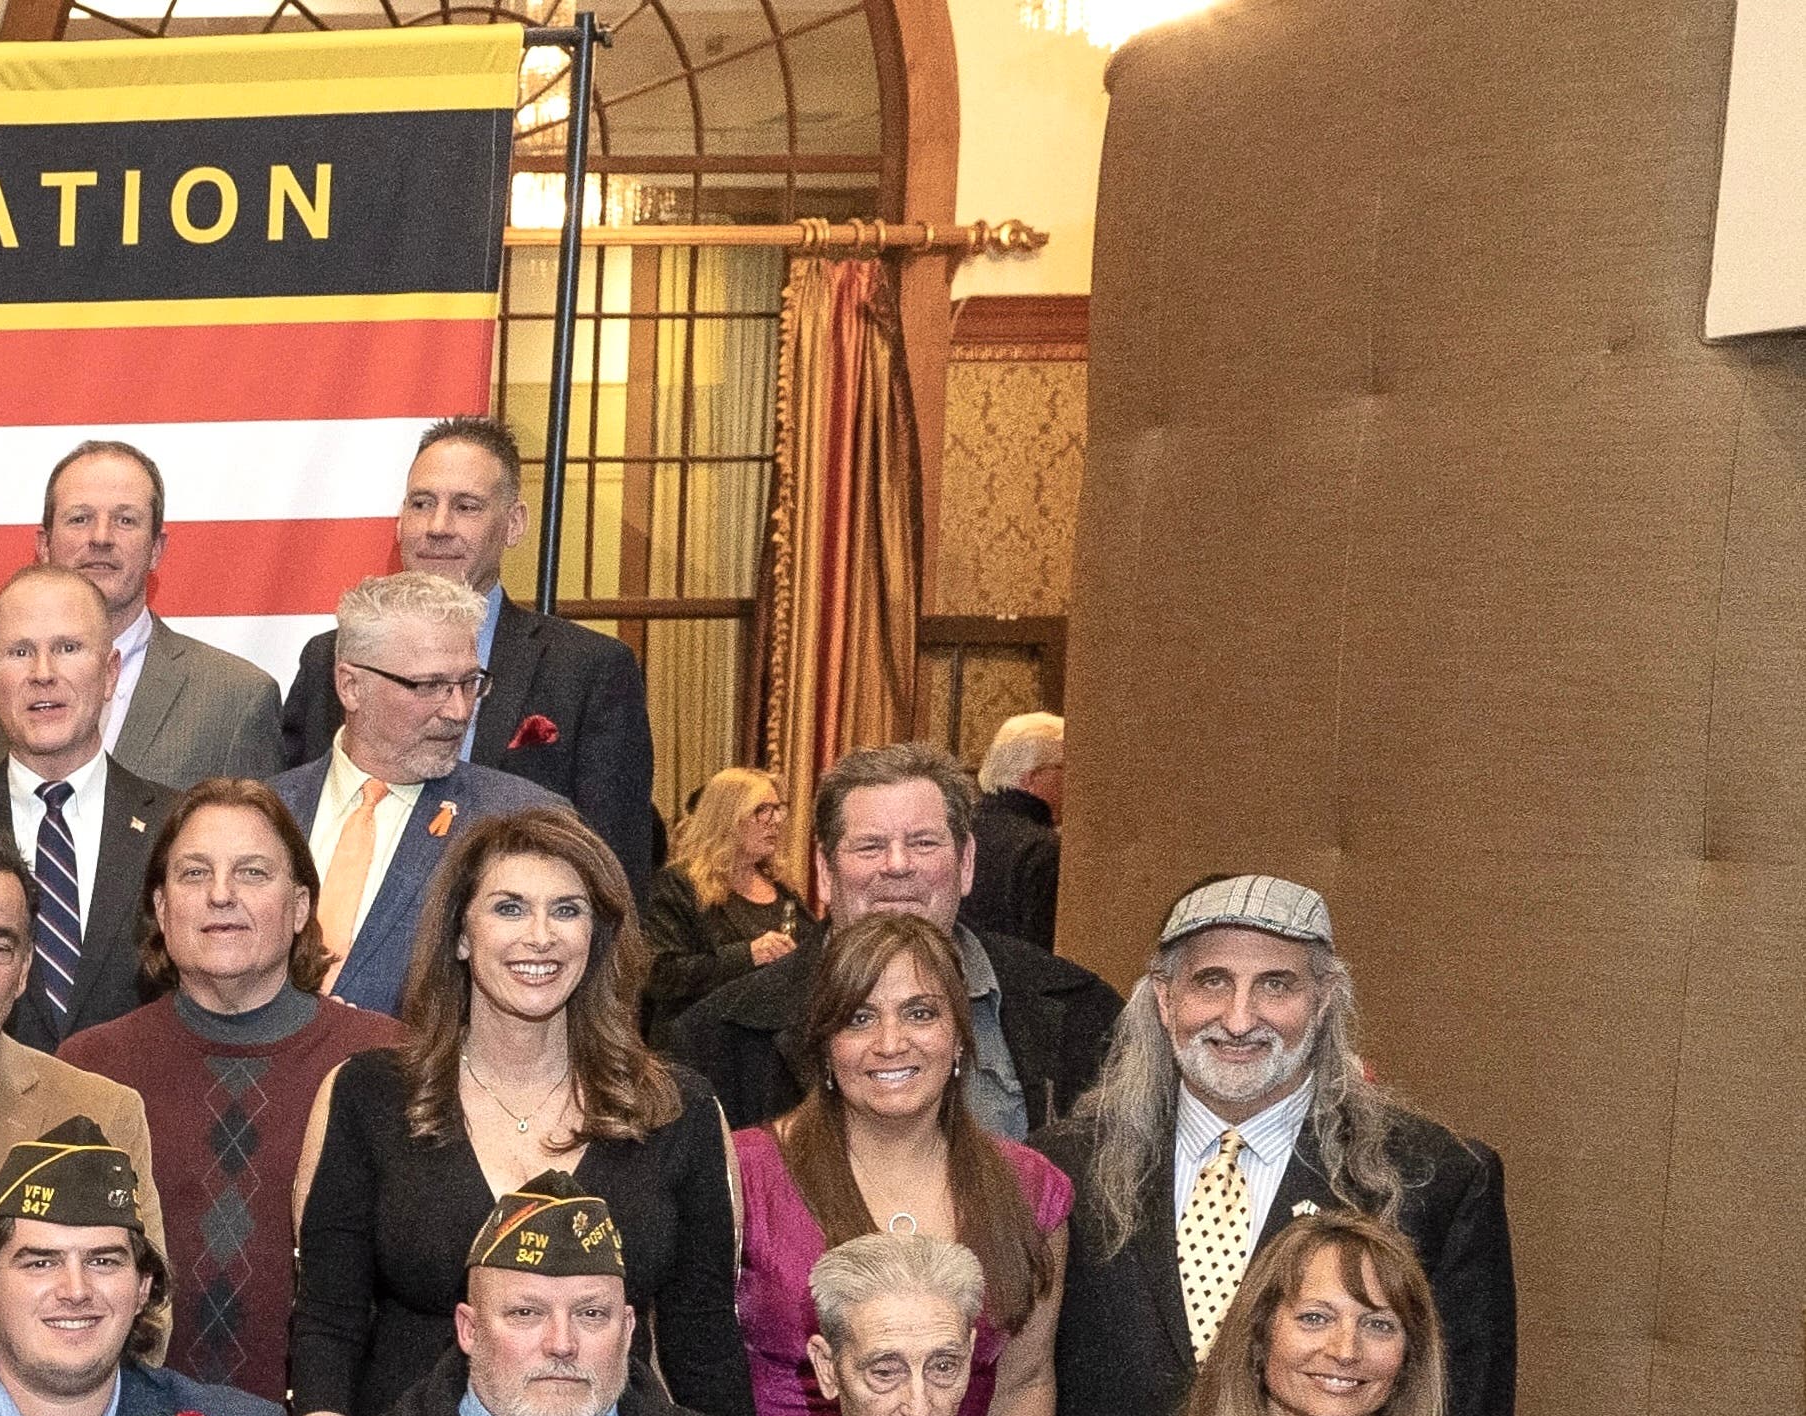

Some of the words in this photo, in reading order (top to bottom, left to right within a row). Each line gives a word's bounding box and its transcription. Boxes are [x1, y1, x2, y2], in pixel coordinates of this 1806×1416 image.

[25, 1185, 55, 1201] VFW
[22, 1200, 50, 1216] 347
[520, 1231, 549, 1248] VFW
[581, 1222, 607, 1253] POST
[516, 1248, 544, 1265] 347
